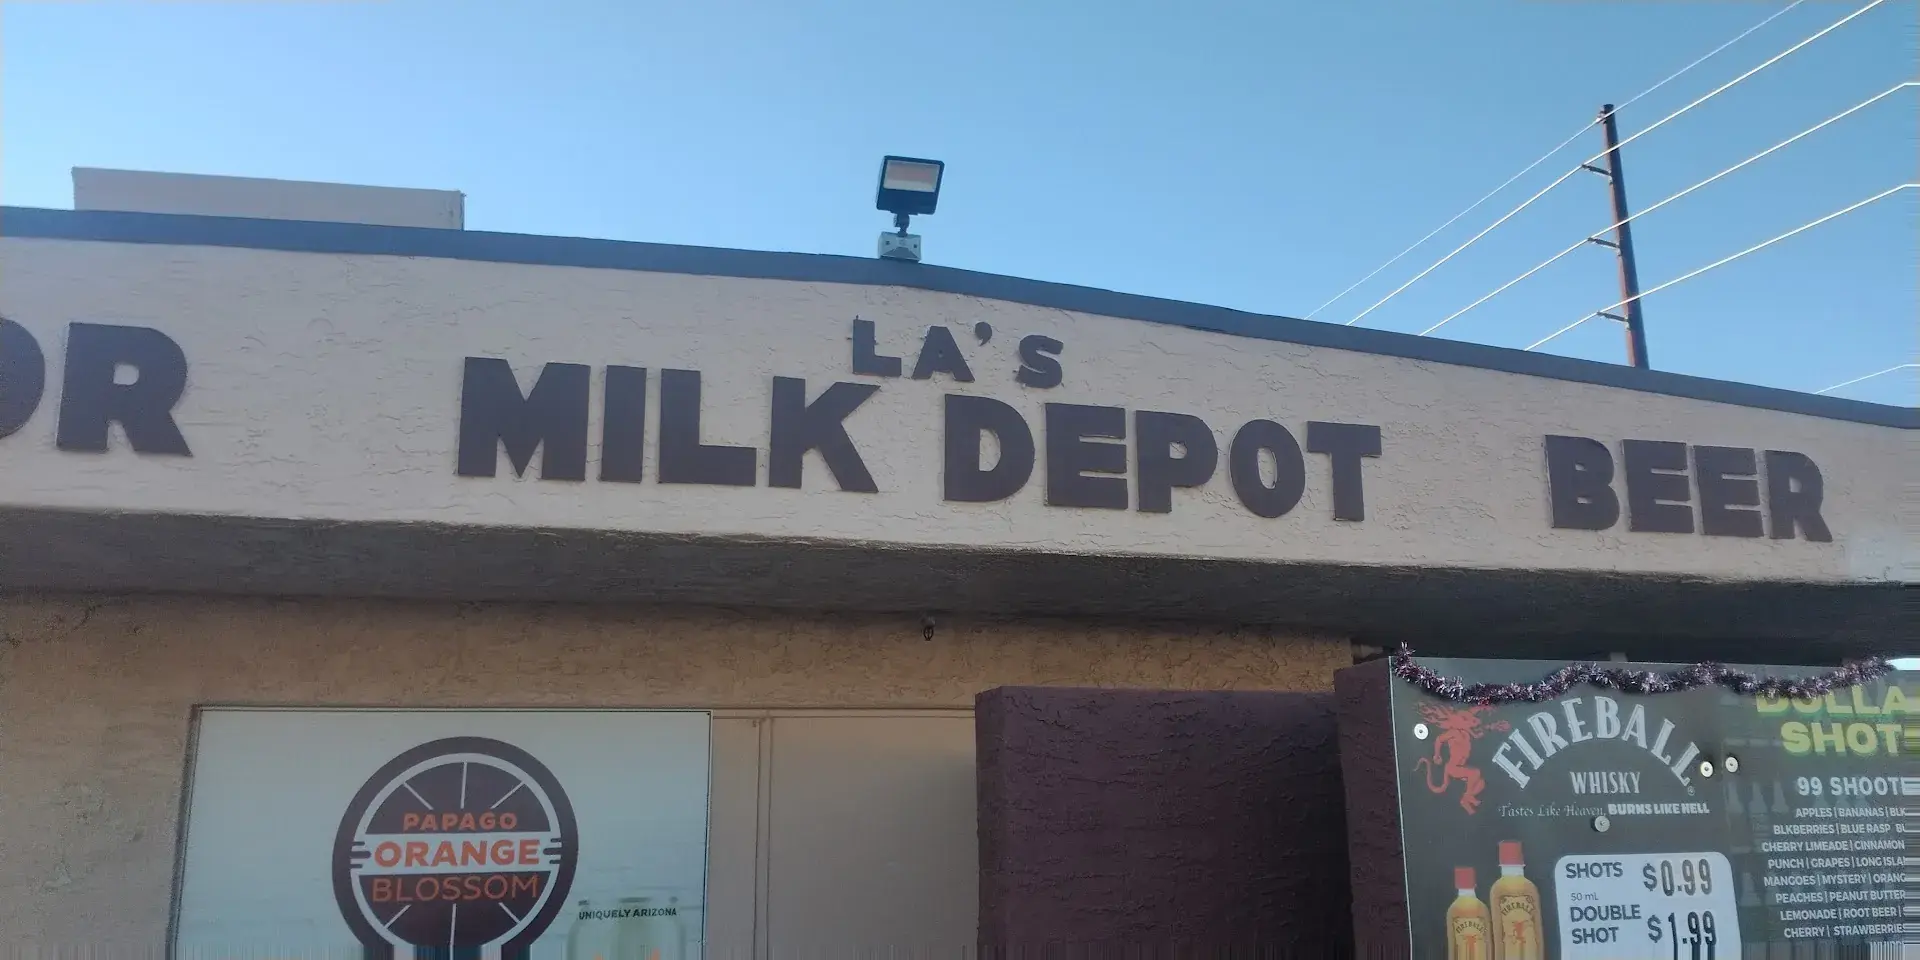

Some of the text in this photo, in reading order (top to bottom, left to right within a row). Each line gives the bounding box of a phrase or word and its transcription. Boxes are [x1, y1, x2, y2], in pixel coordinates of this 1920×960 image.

[852, 317, 1064, 389] LA'S
[457, 356, 1382, 522] MILK DEPOT
[1545, 434, 1833, 543] BEER
[1492, 695, 1700, 789] FIREBALL
[1780, 721, 1905, 754] SHOT
[1569, 771, 1641, 794] WHISKY
[1797, 776, 1823, 796] 99
[1498, 802, 1534, 817] Tastes
[1537, 802, 1561, 817] Like
[1607, 803, 1651, 815] BURNS
[1654, 803, 1680, 815] LIKE
[1681, 803, 1710, 815] HELL
[1795, 807, 1832, 818] APPLES
[1838, 807, 1884, 818] BANANAS
[403, 812, 517, 831] PAPAGO
[1773, 824, 1835, 835] BLKBERRIES
[1840, 823, 1865, 834] BLUE
[1866, 823, 1891, 834] RASP
[374, 839, 541, 868] ORANGE
[1761, 840, 1905, 852] CHERRY LIMEADE CINNAMON
[1768, 858, 1805, 870] PUNCH
[1811, 857, 1850, 868] GRAPES
[1857, 857, 1883, 867] LONG
[1565, 858, 1712, 896] SHOTS $0.99
[1763, 875, 1815, 887] MANGOES
[1822, 874, 1867, 885] MYSTERY
[372, 875, 540, 902] BLOSSOM
[1570, 892, 1599, 901] 50 mL
[1775, 889, 1906, 903] PEACHES PEANUT BUTTER
[578, 907, 677, 920] UNIQUELY ARIZONA
[1780, 908, 1837, 921] LEMONADE
[1843, 907, 1871, 918] ROOT
[1871, 906, 1897, 917] BEER
[1570, 904, 1716, 947] DOUBLE $1.99
[1783, 925, 1826, 938] CHERRY
[1571, 926, 1619, 945] SHOT
